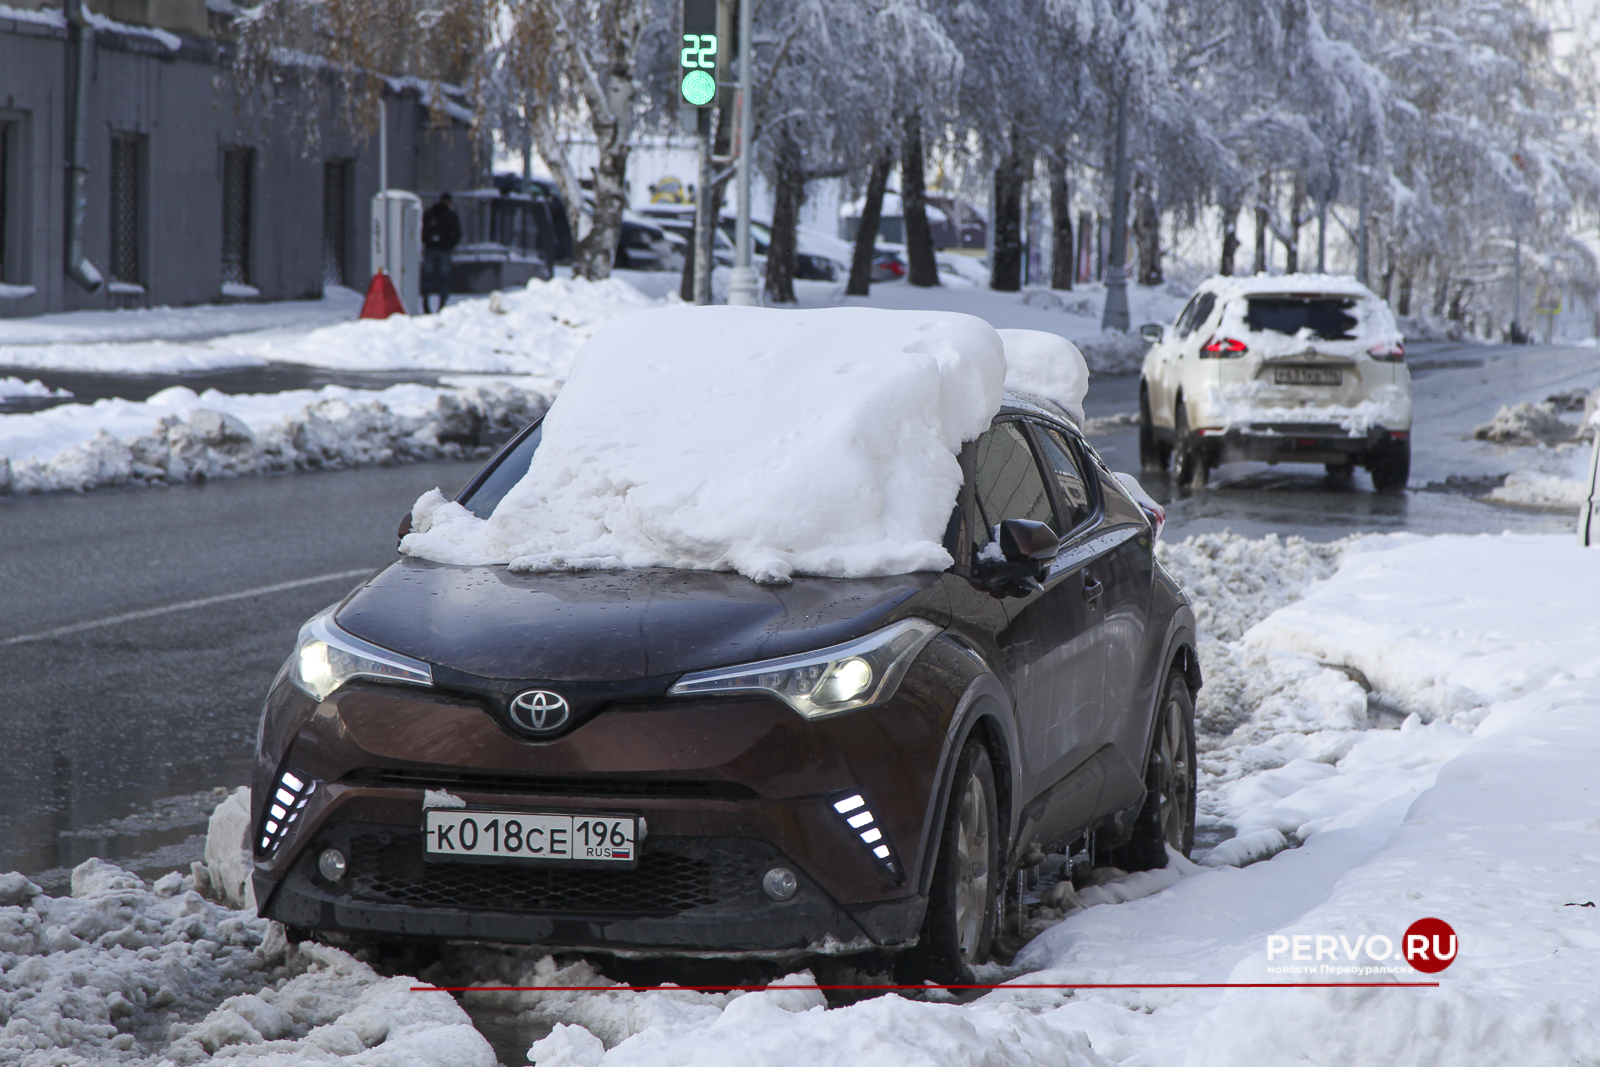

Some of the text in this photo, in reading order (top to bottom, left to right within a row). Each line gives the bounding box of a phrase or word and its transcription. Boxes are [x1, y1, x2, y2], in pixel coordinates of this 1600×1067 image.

[681, 34, 718, 69] 22
[576, 820, 626, 847] 196
[586, 847, 611, 857] RUS
